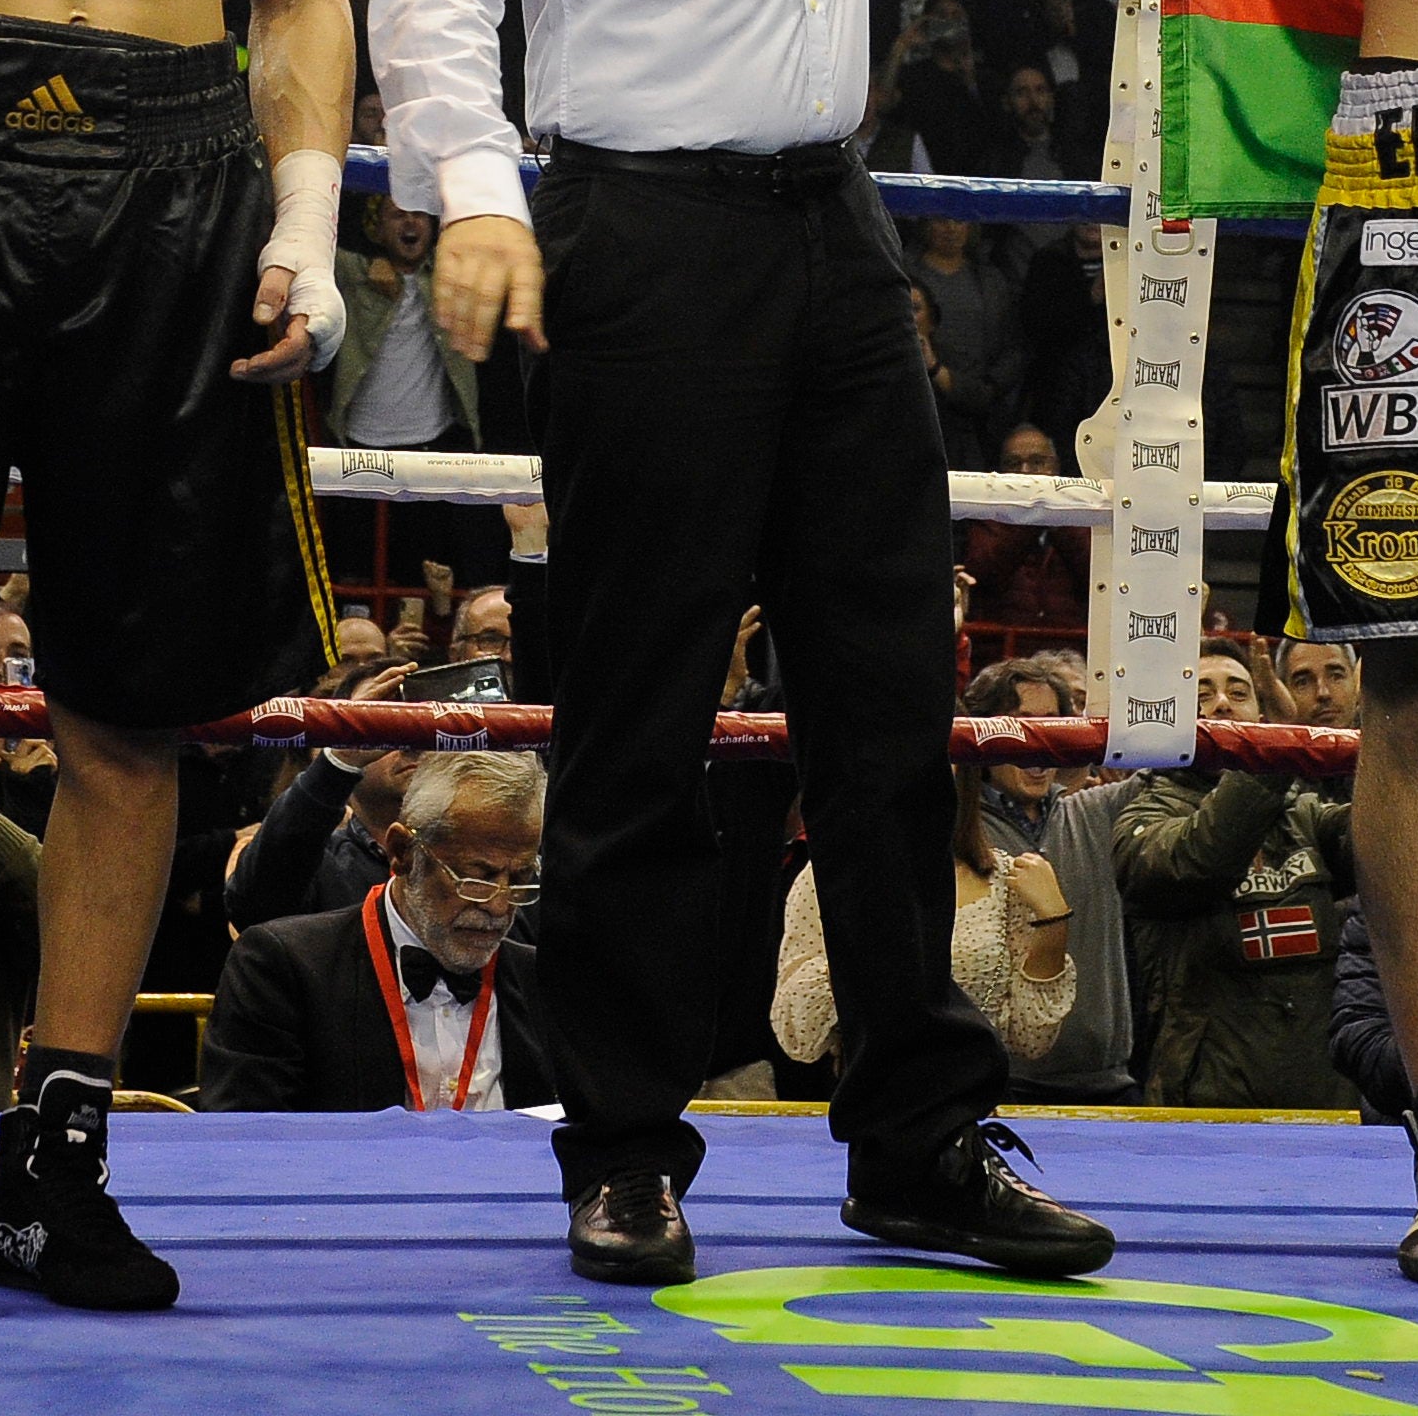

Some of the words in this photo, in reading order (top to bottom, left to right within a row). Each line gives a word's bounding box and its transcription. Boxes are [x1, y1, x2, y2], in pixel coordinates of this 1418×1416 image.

[5, 110, 97, 133] adidas
[1140, 274, 1188, 306] CHARLIE
[1135, 358, 1180, 390] CHARLIE
[342, 451, 394, 480] CHARLIE
[1133, 440, 1179, 472] CHARLIE
[1131, 525, 1179, 557] CHARLIE
[1128, 611, 1177, 643] CHARLIE
[1128, 696, 1175, 727] CHARLIE
[977, 717, 1026, 744] CHARLIE
[1239, 861, 1305, 894] ORWAY
